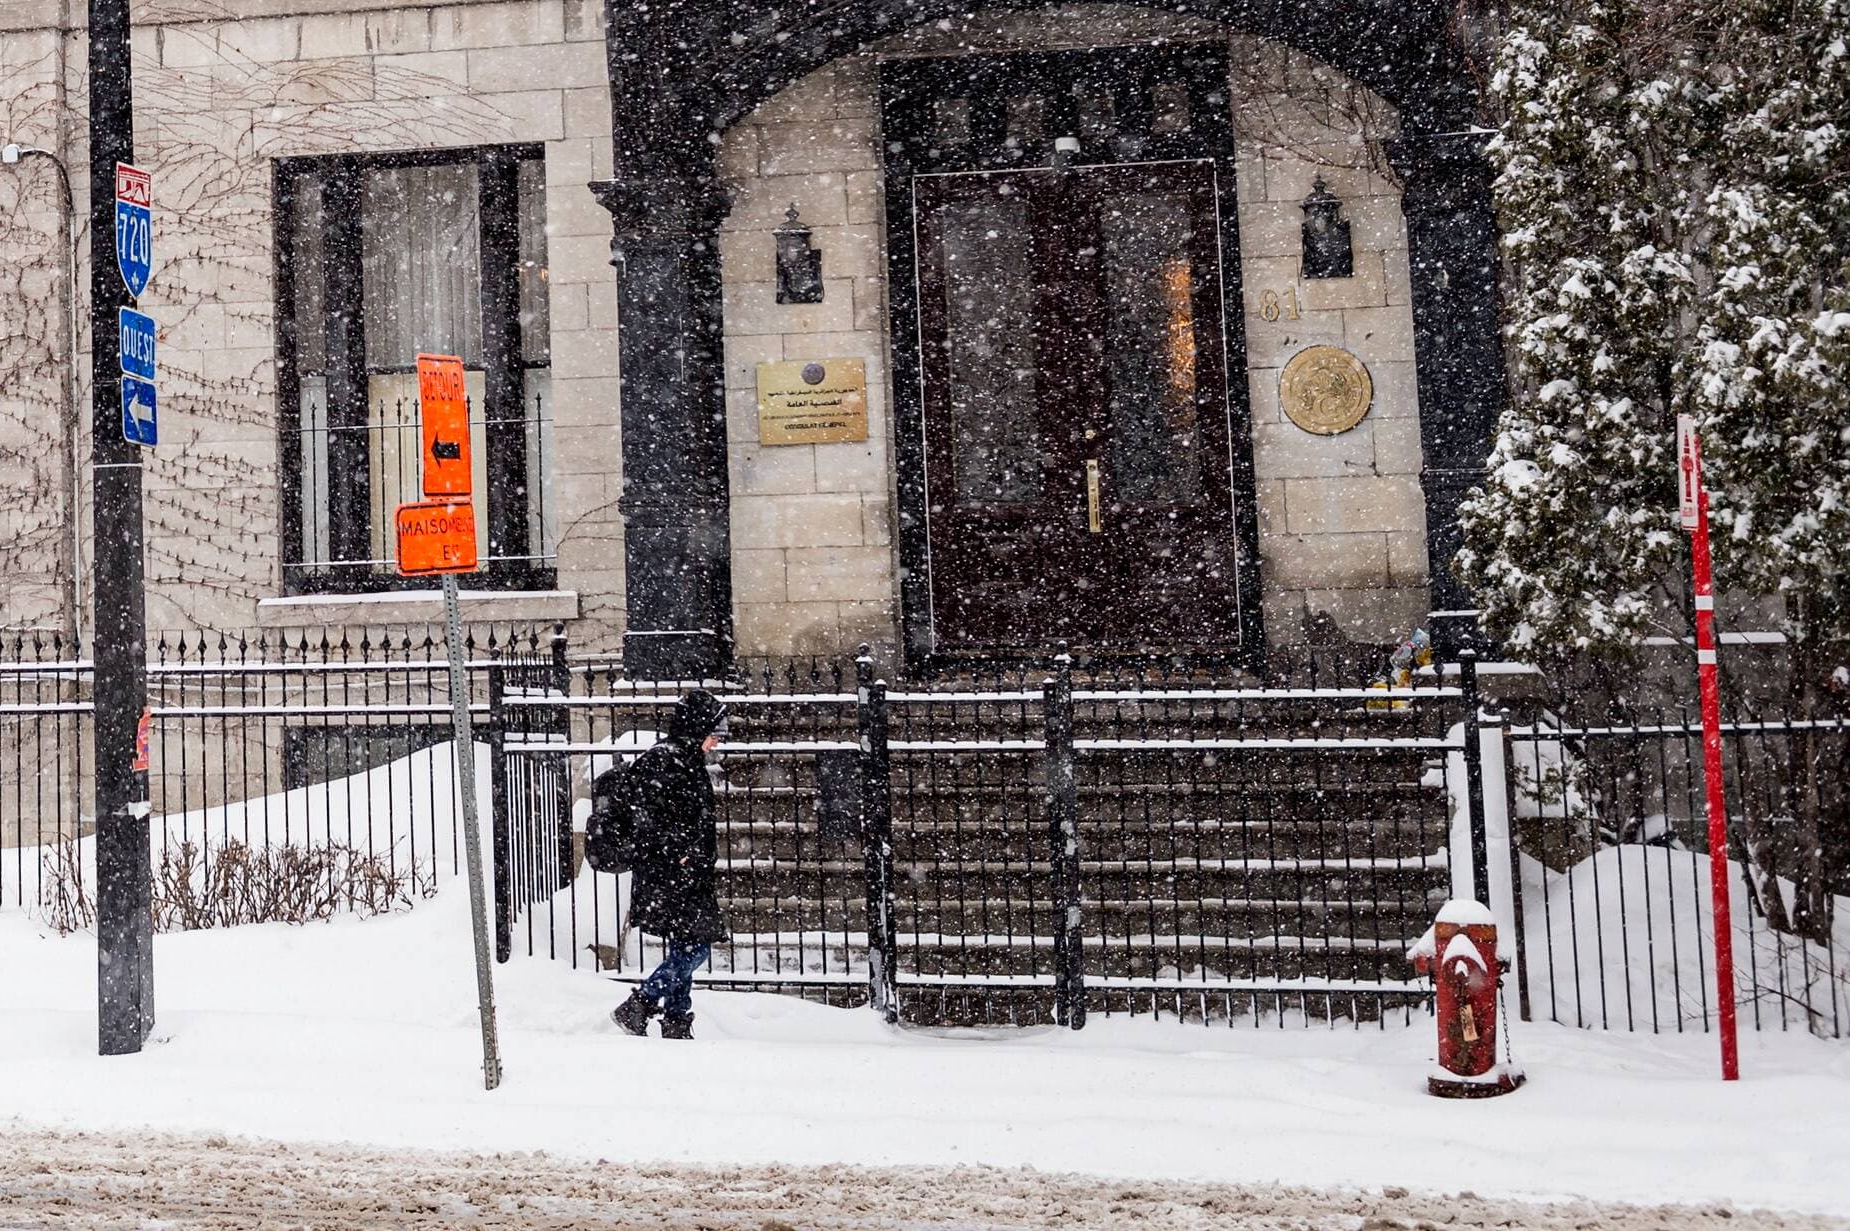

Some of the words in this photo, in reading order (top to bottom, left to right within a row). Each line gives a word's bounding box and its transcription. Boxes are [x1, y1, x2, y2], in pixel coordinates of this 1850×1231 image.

[120, 213, 149, 267] 720
[1259, 287, 1300, 322] 81
[123, 324, 154, 365] OUEST
